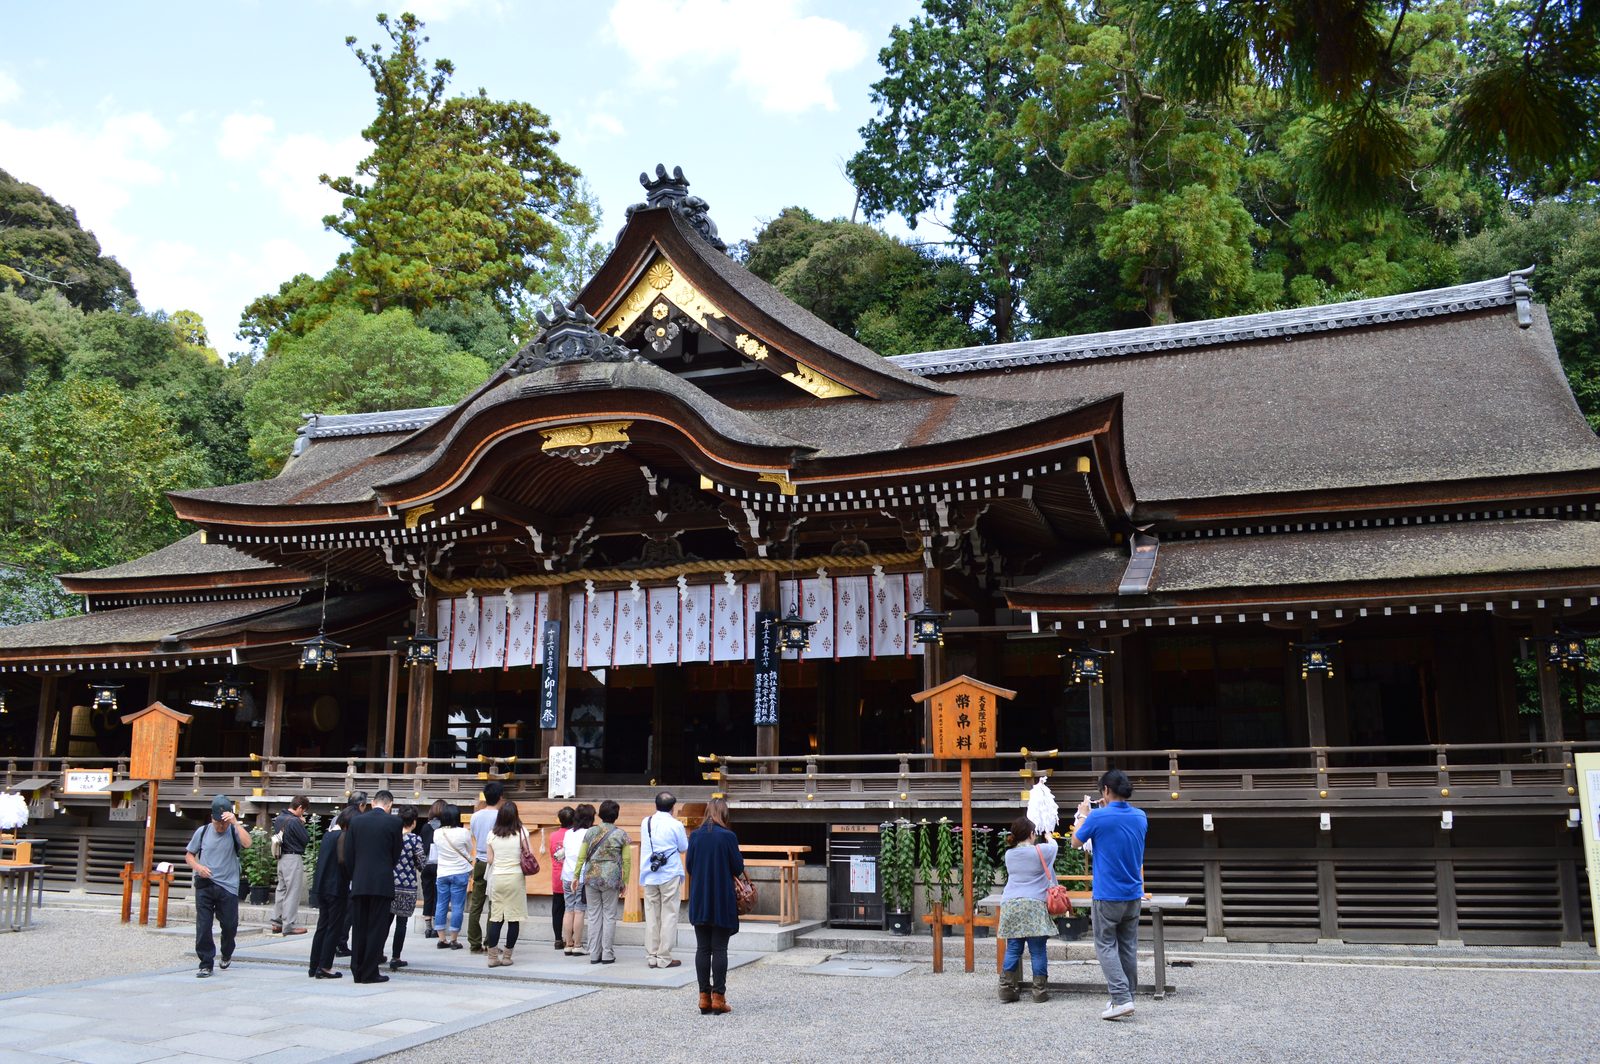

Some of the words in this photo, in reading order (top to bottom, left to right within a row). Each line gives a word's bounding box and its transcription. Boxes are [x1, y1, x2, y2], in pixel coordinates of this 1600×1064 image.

[542, 676, 555, 722] 卯の日祭
[956, 694, 972, 750] 幣帛料
[978, 696, 987, 750] 天皇陛下御下賜
